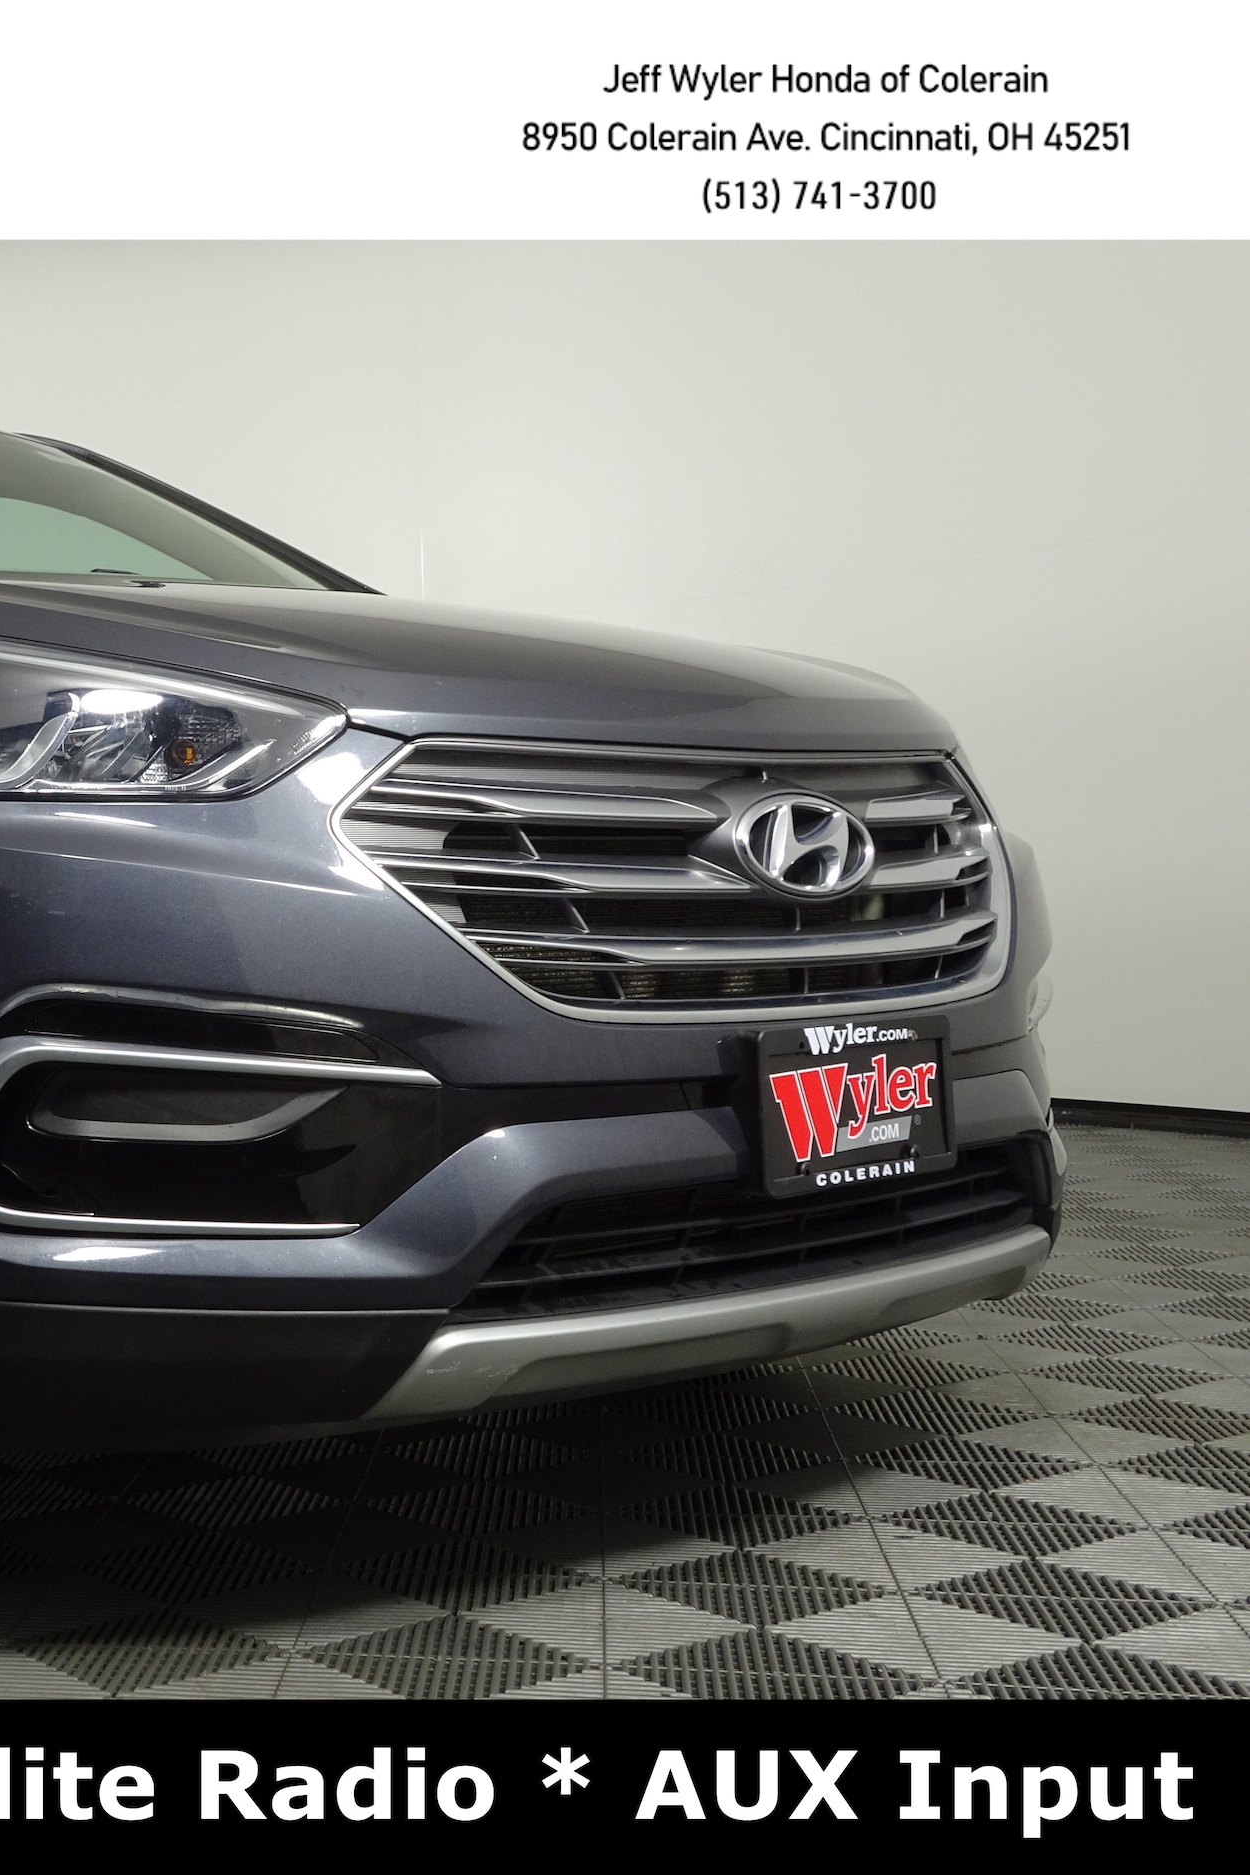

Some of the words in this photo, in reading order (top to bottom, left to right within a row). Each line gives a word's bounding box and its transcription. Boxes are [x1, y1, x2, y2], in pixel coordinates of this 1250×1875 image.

[769, 1054, 937, 1162] Wyler
[868, 1123, 899, 1142] .COM
[815, 1160, 916, 1187] COLERAIN
